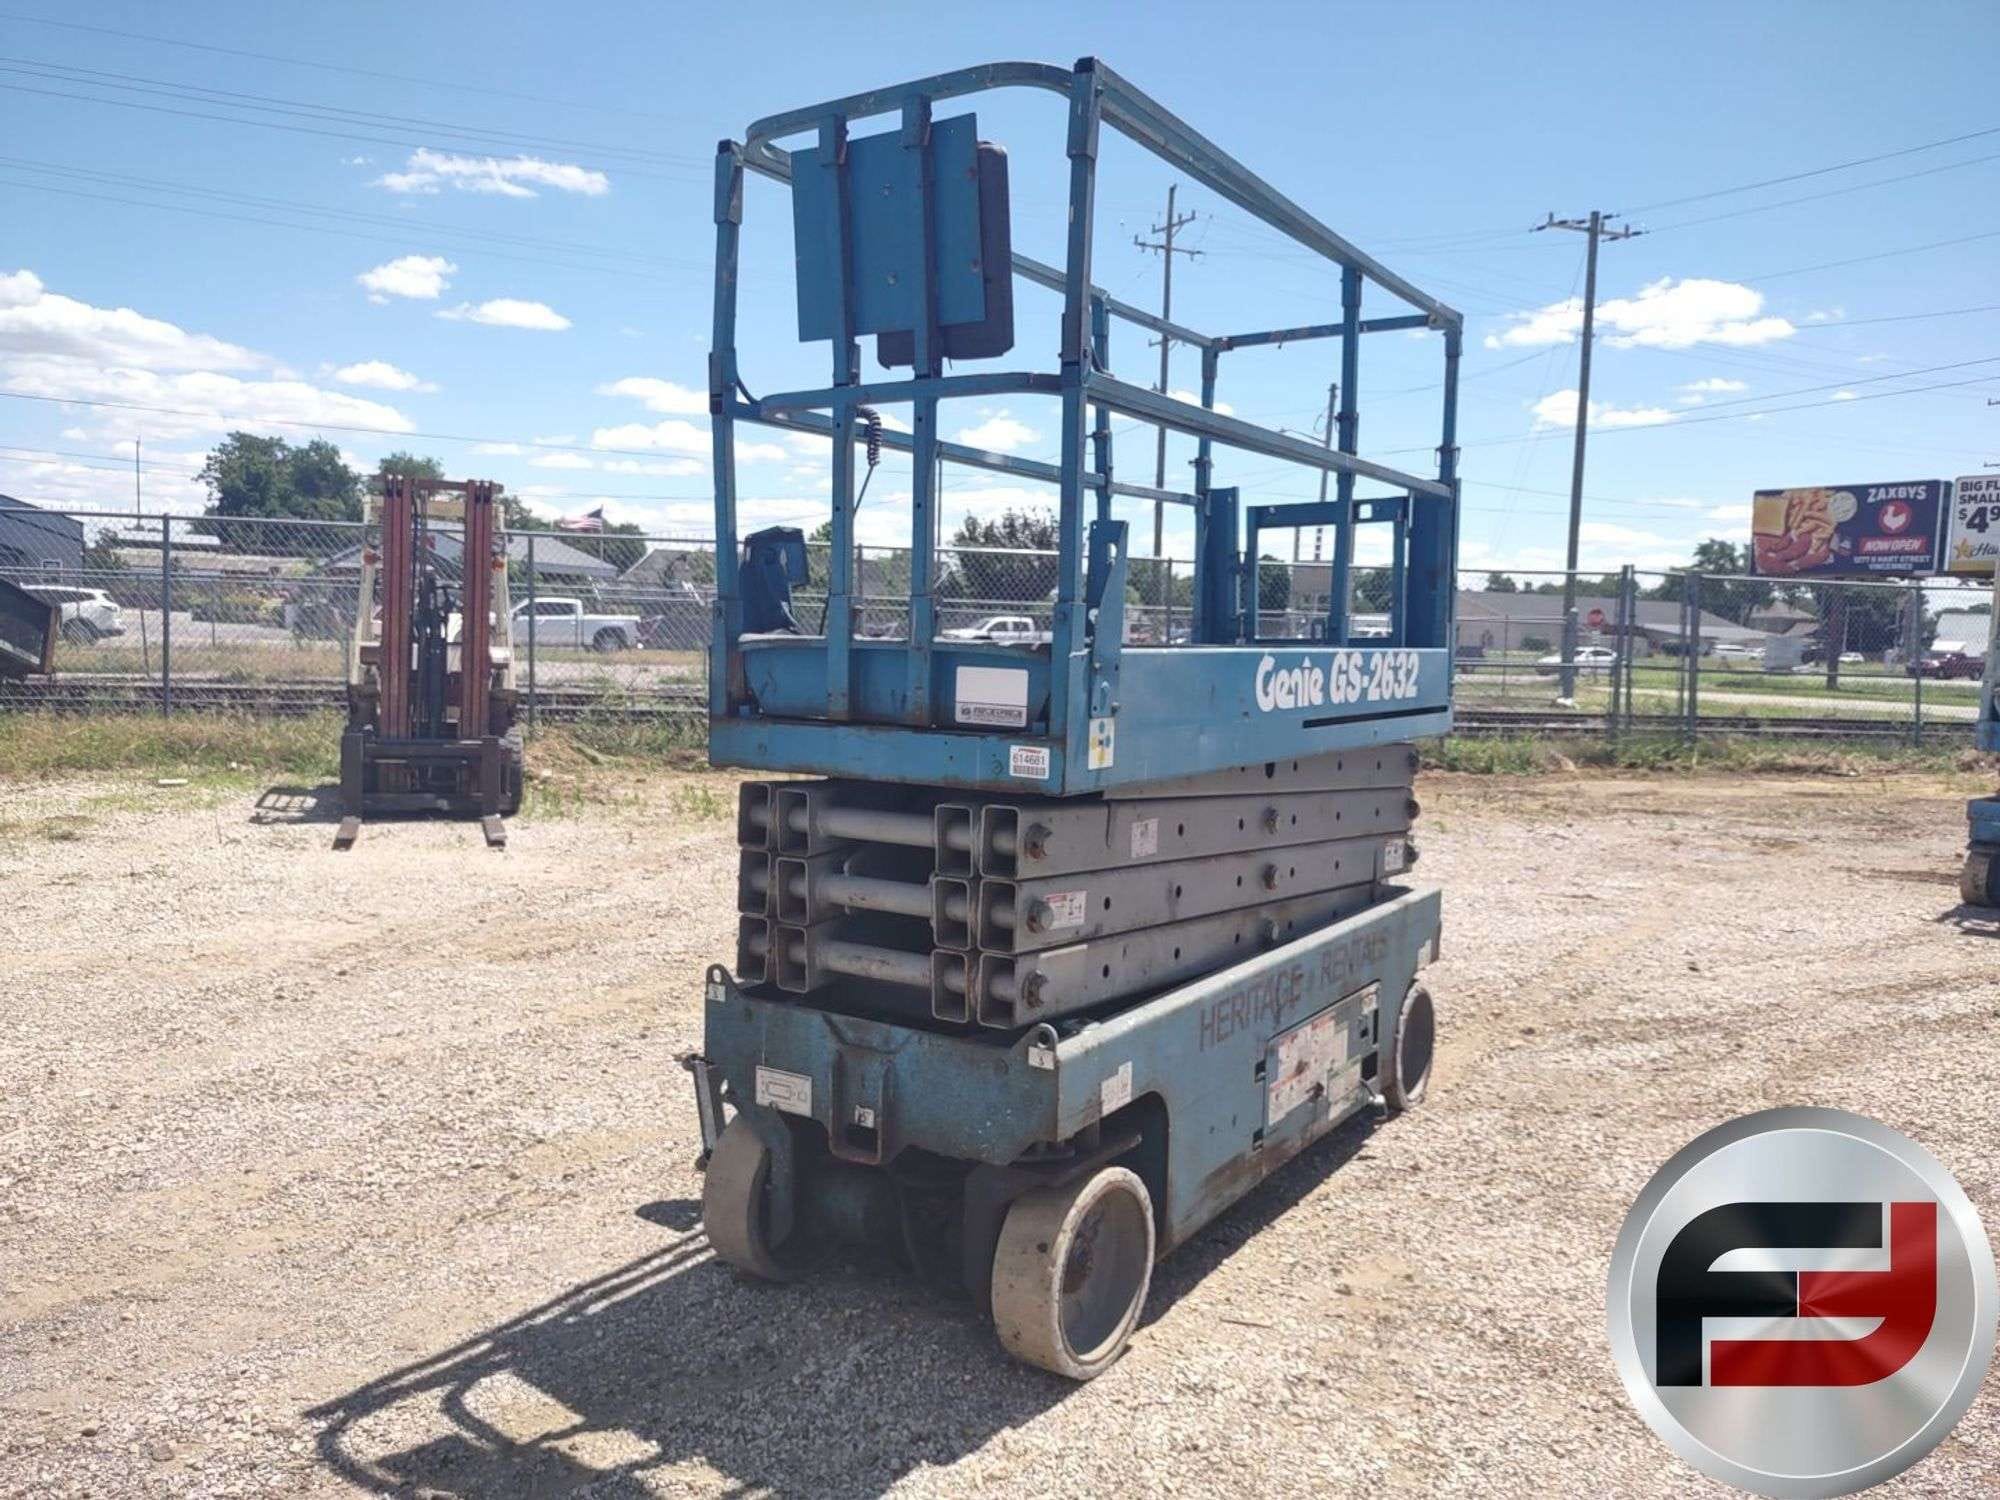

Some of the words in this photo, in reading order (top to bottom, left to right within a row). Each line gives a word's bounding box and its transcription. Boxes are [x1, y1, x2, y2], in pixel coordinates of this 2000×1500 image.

[1867, 485, 1927, 503] ZAXBYS
[1960, 481, 1983, 492] BIG
[1892, 538, 1922, 551] OPEN
[1256, 655, 1324, 712] Genie
[1329, 651, 1419, 704] GS-2632
[1200, 967, 1304, 1051] HERITAGE
